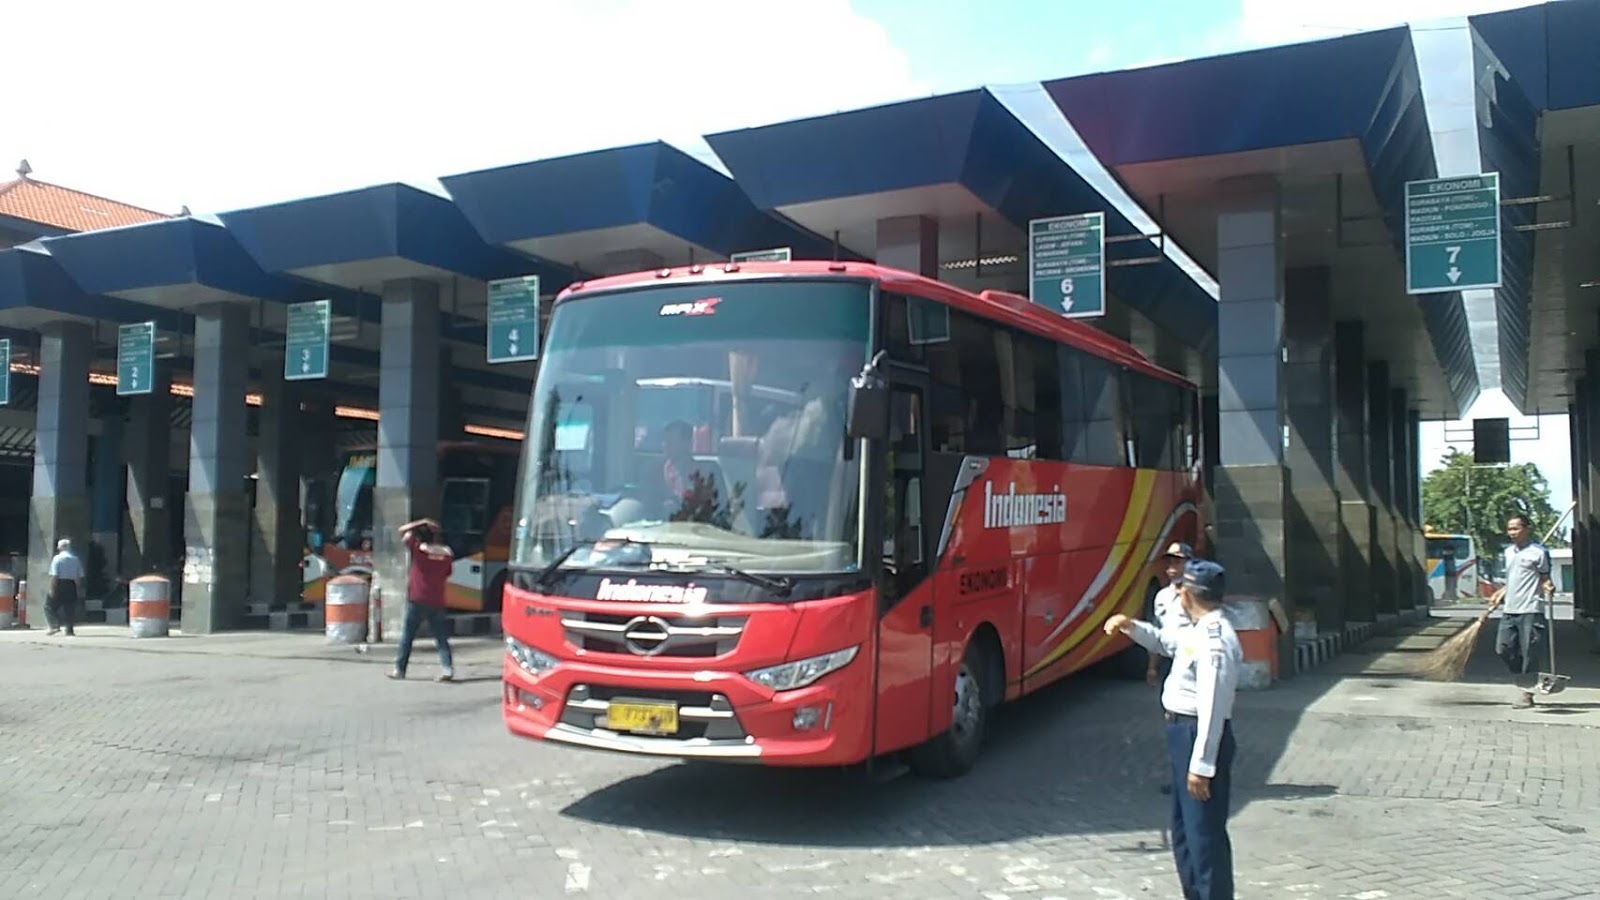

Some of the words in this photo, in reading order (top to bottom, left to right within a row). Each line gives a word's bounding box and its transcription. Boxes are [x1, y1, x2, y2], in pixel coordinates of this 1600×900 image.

[1429, 179, 1481, 192] EKONOMI
[1048, 219, 1090, 231] EKONOMI
[1445, 246, 1462, 264] 7
[1060, 278, 1074, 295] 6
[508, 329, 519, 341] 4
[302, 349, 310, 361] 3
[131, 366, 138, 378] 2
[984, 480, 1067, 529] Indonesia
[596, 577, 708, 604] Indonesia
